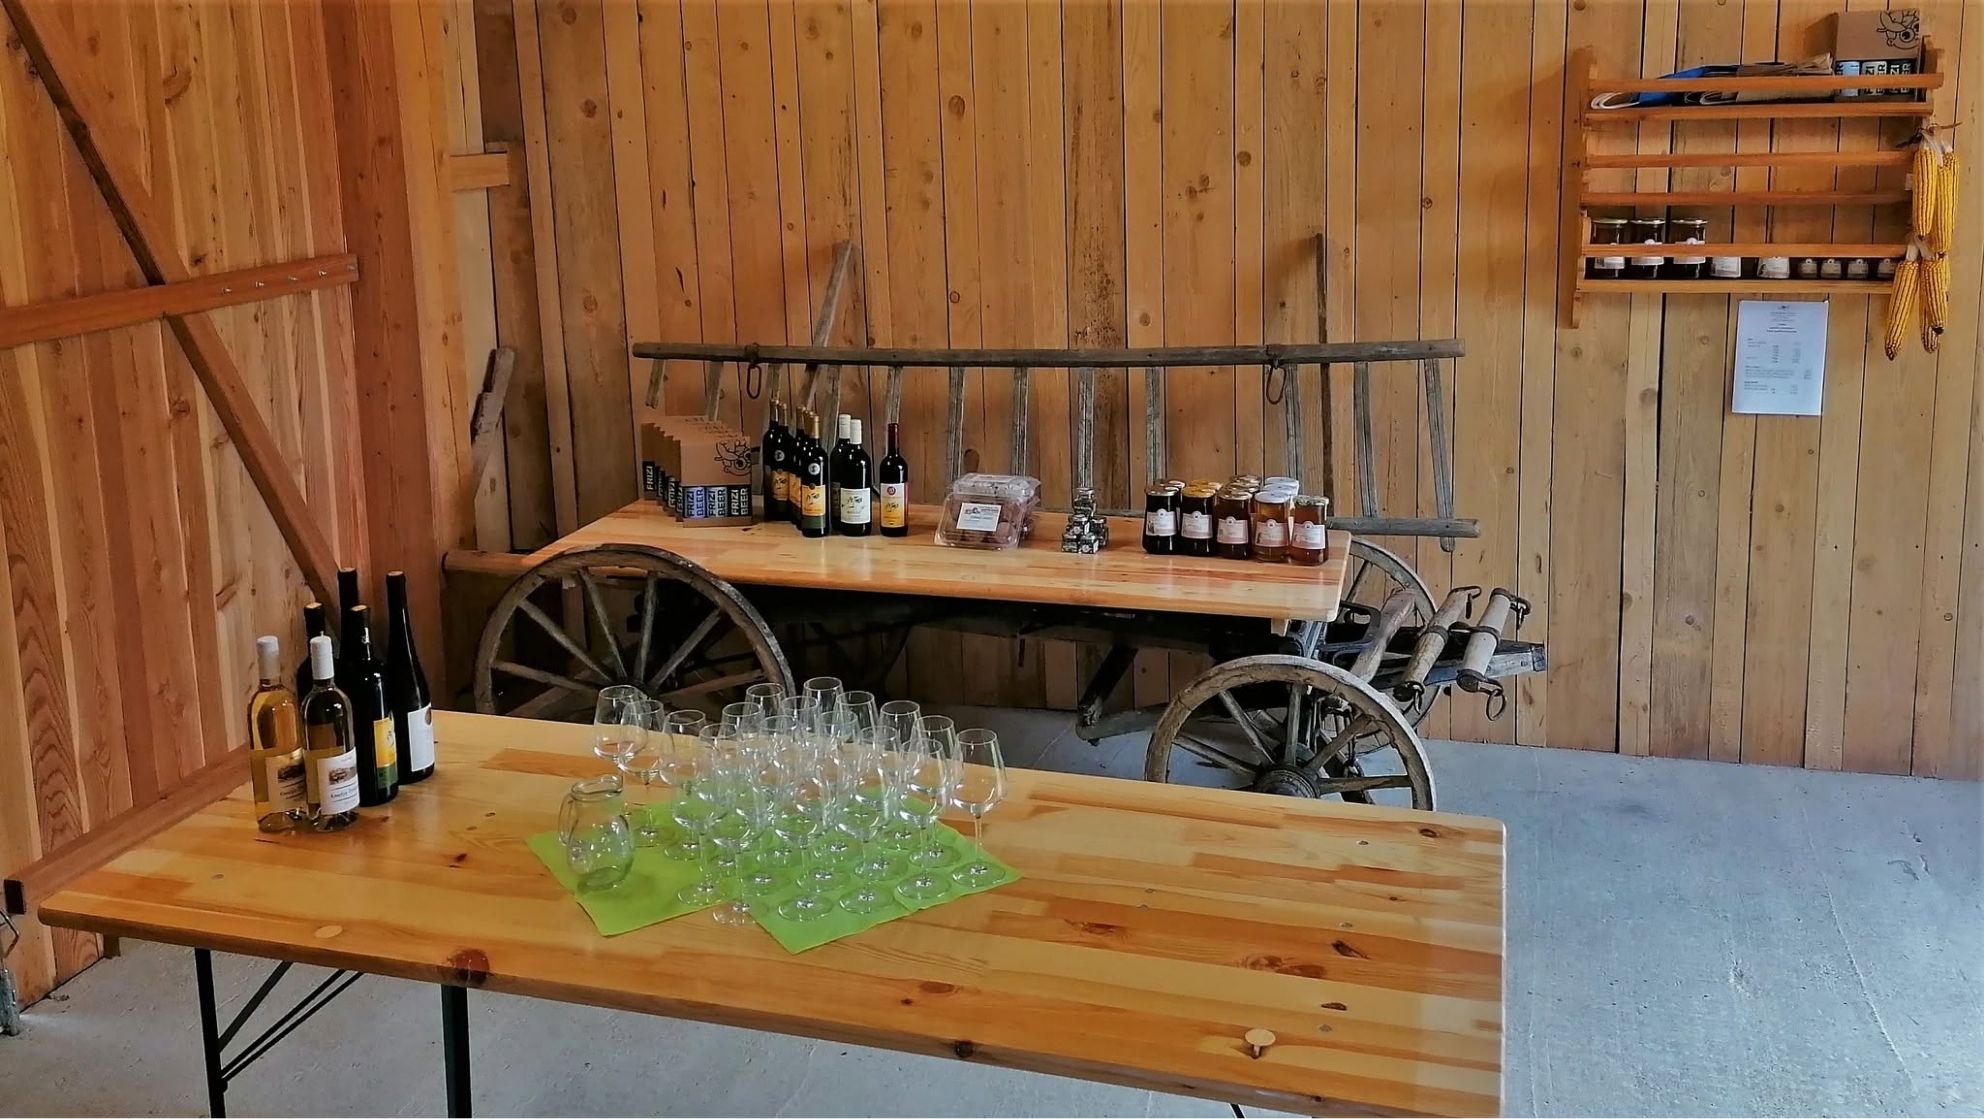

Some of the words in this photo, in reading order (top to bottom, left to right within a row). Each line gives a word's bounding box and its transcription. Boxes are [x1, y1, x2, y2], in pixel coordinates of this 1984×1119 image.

[687, 490, 695, 516] FRIZI
[696, 488, 704, 516] BEER
[717, 488, 726, 516] BEER
[731, 489, 739, 515] FRIZI
[740, 488, 748, 515] BEER
